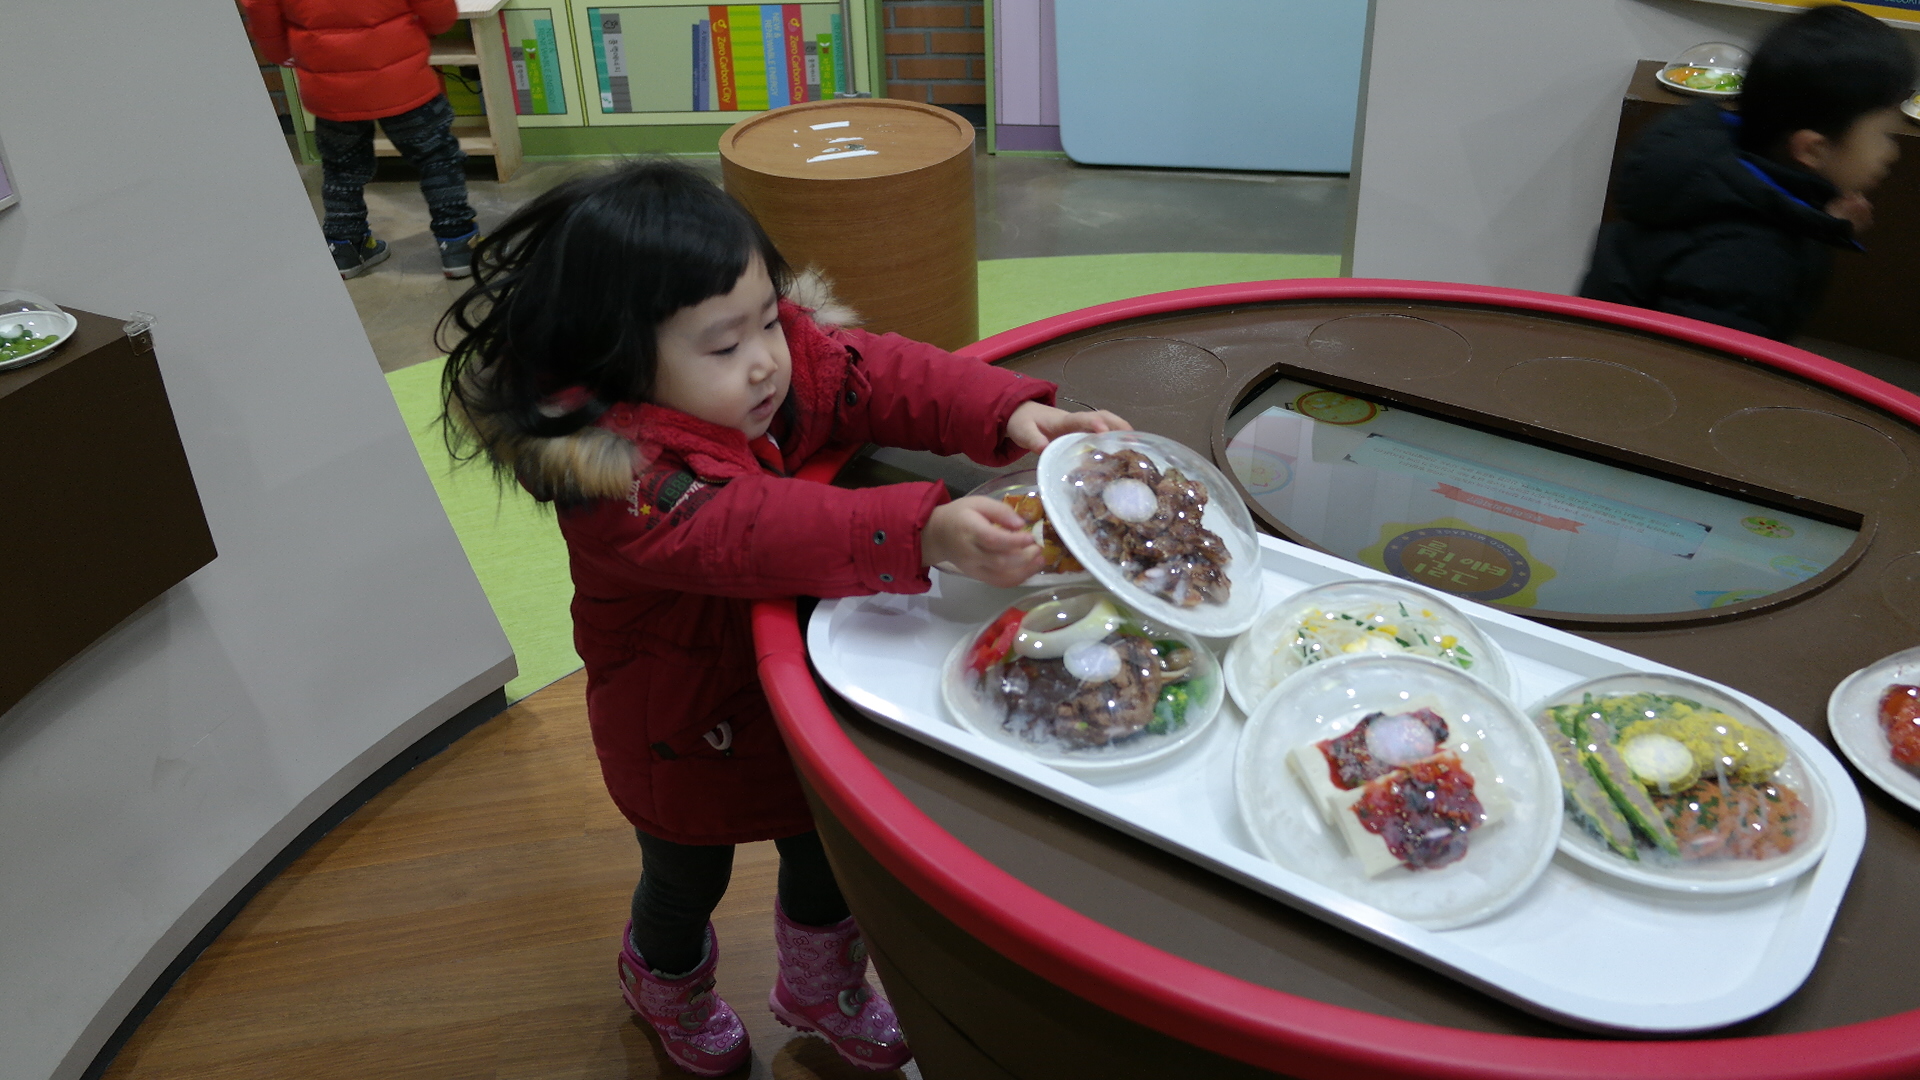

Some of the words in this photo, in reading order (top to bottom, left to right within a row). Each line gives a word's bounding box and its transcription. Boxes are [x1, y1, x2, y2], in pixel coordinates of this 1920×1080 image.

[772, 12, 782, 31] NEW
[717, 36, 727, 56] Zero
[764, 20, 777, 65] RENEWABLE
[789, 35, 800, 54] Zero
[719, 56, 730, 86] Carbon
[791, 55, 802, 85] Carbon
[768, 66, 779, 97] ENERGY
[721, 86, 733, 103] City
[792, 86, 804, 102] City
[1434, 529, 1487, 541] MILEAGE
[1416, 540, 1508, 577] 테이블
[1490, 540, 1515, 557] FOOD
[1413, 560, 1480, 586] 그린
